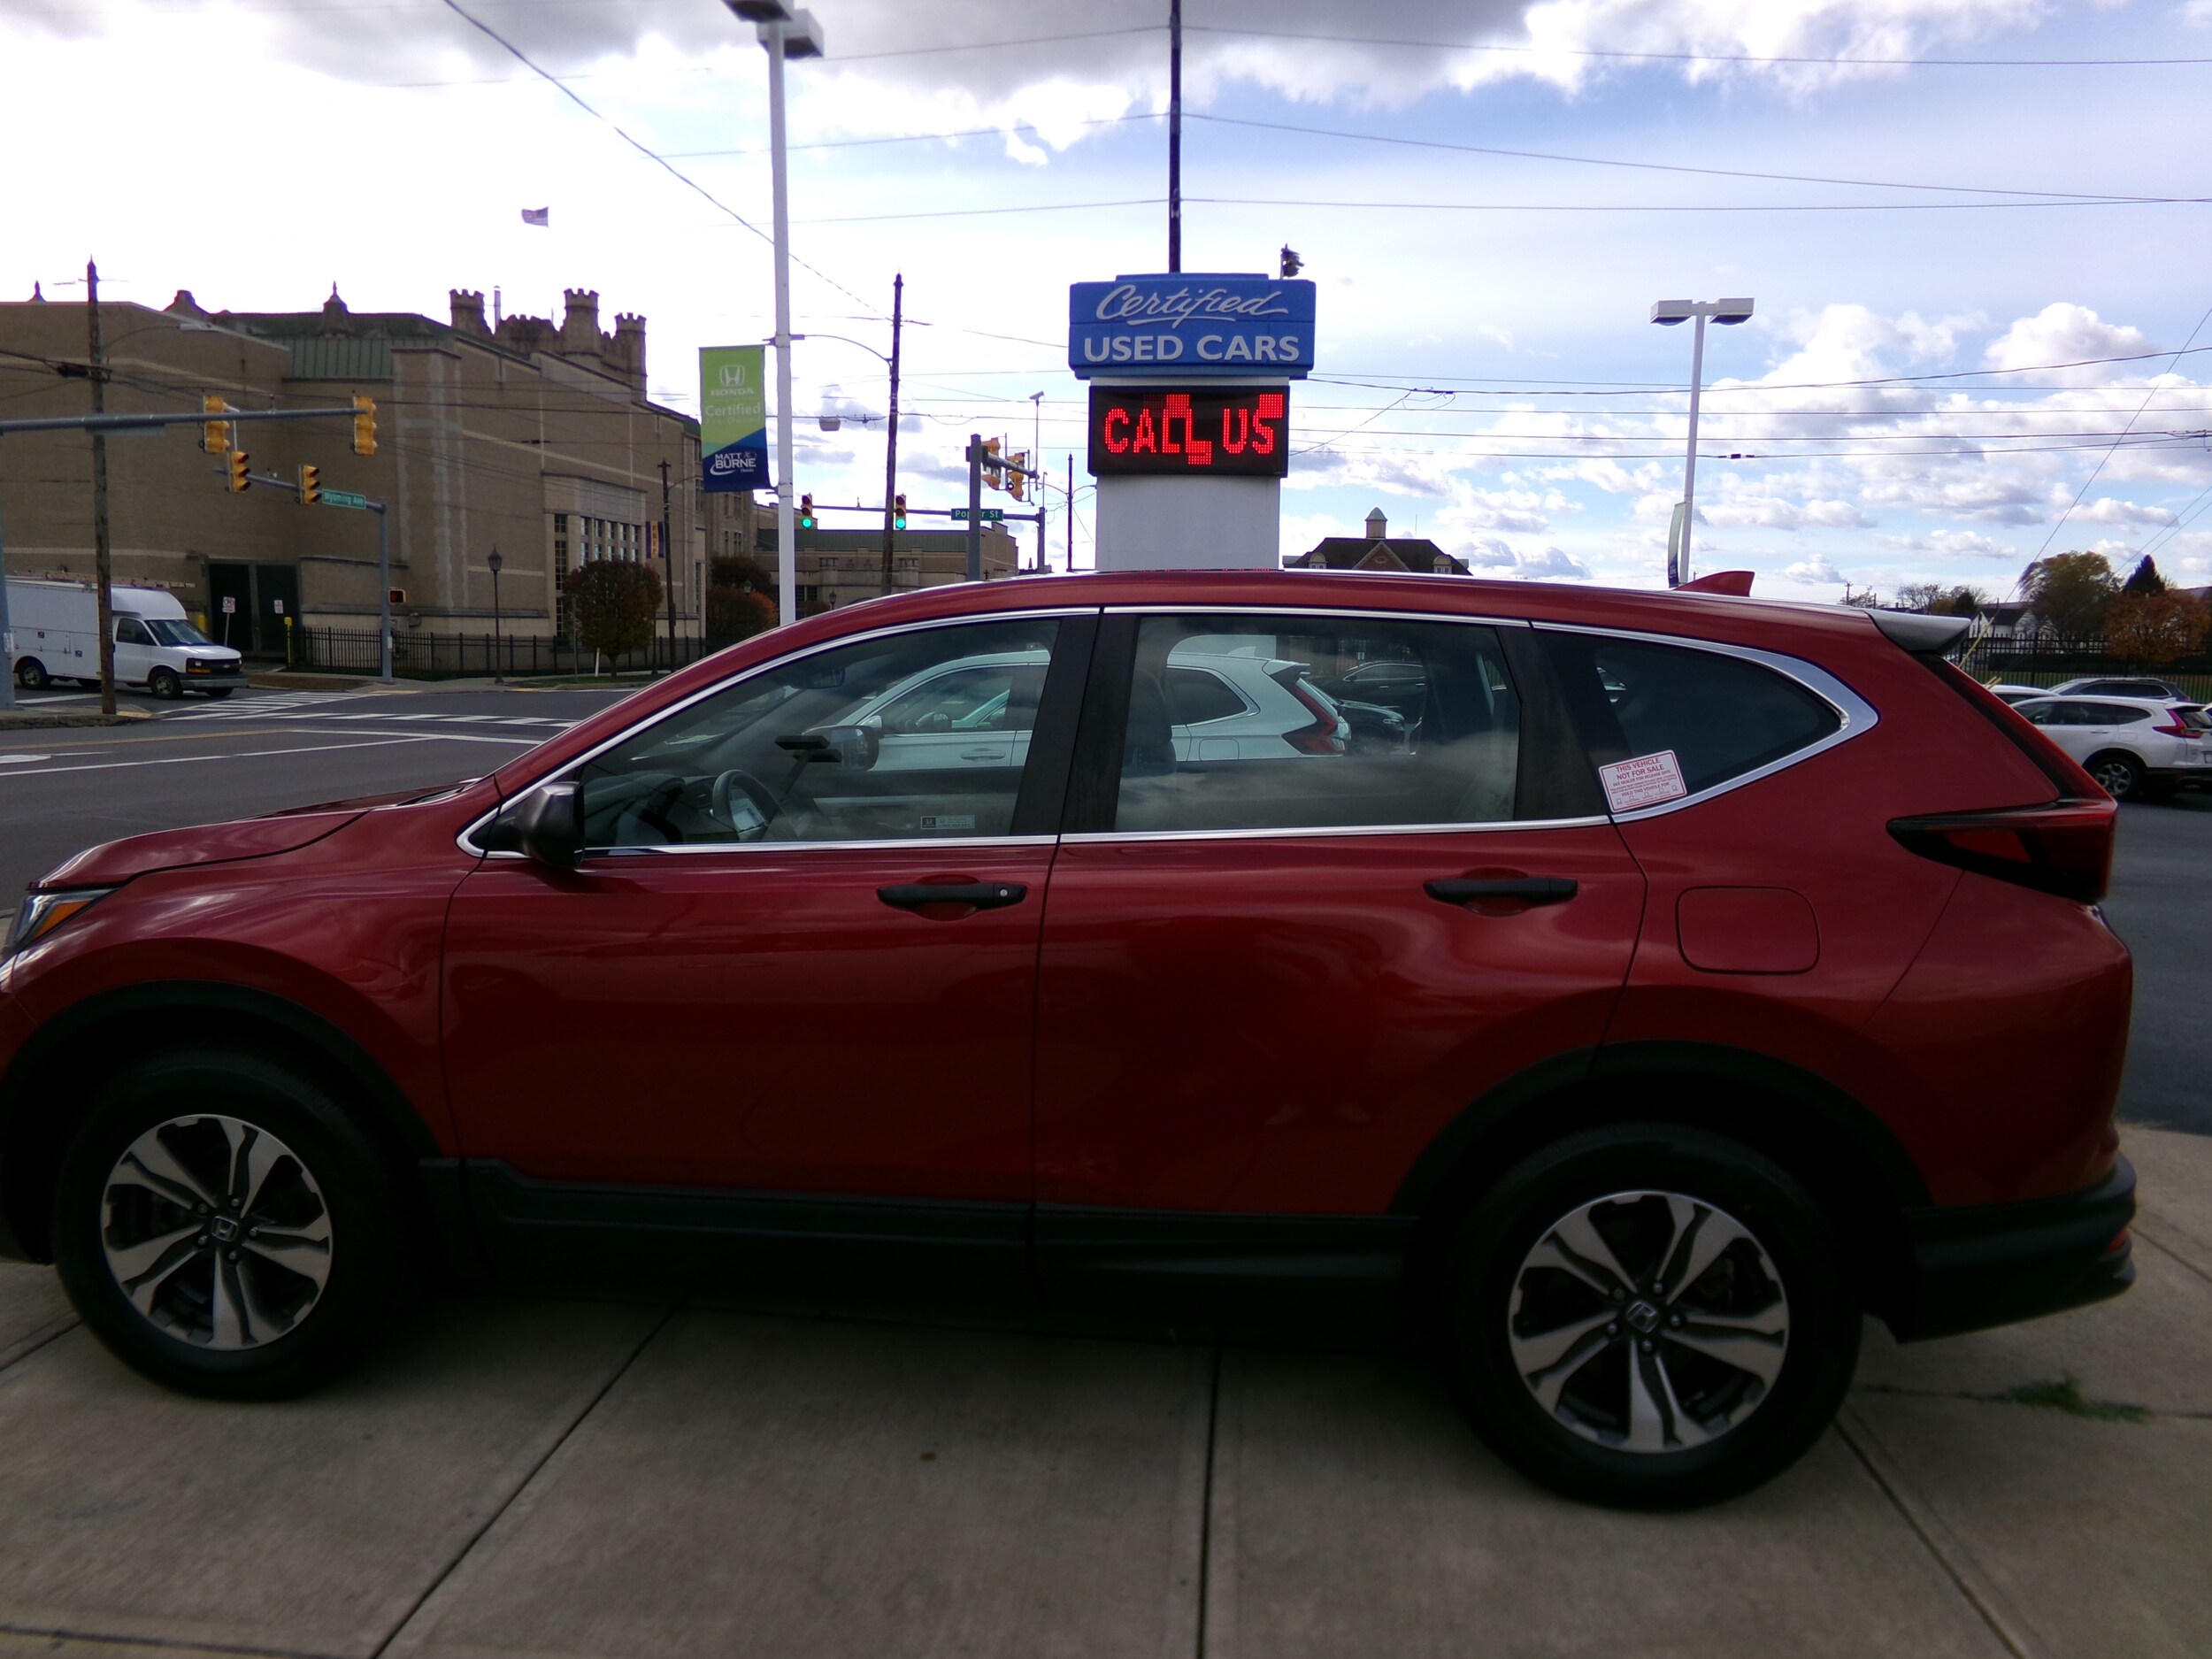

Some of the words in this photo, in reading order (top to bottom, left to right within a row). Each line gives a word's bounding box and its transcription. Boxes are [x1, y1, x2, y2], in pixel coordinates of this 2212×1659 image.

[1096, 285, 1288, 329] Certified
[1084, 335, 1184, 362] USED
[1196, 335, 1300, 361] CARS
[705, 402, 761, 417] Certified
[1223, 408, 1274, 454] US
[715, 457, 757, 469] BURNE
[324, 492, 351, 505] Wyoming
[353, 496, 364, 505] Ave
[989, 510, 999, 518] St
[1616, 764, 1632, 772] THIS
[1632, 758, 1660, 769] VEHICLE
[1617, 772, 1631, 780] NOT
[1647, 764, 1665, 773] SALE
[1643, 784, 1661, 793] VEHICLE
